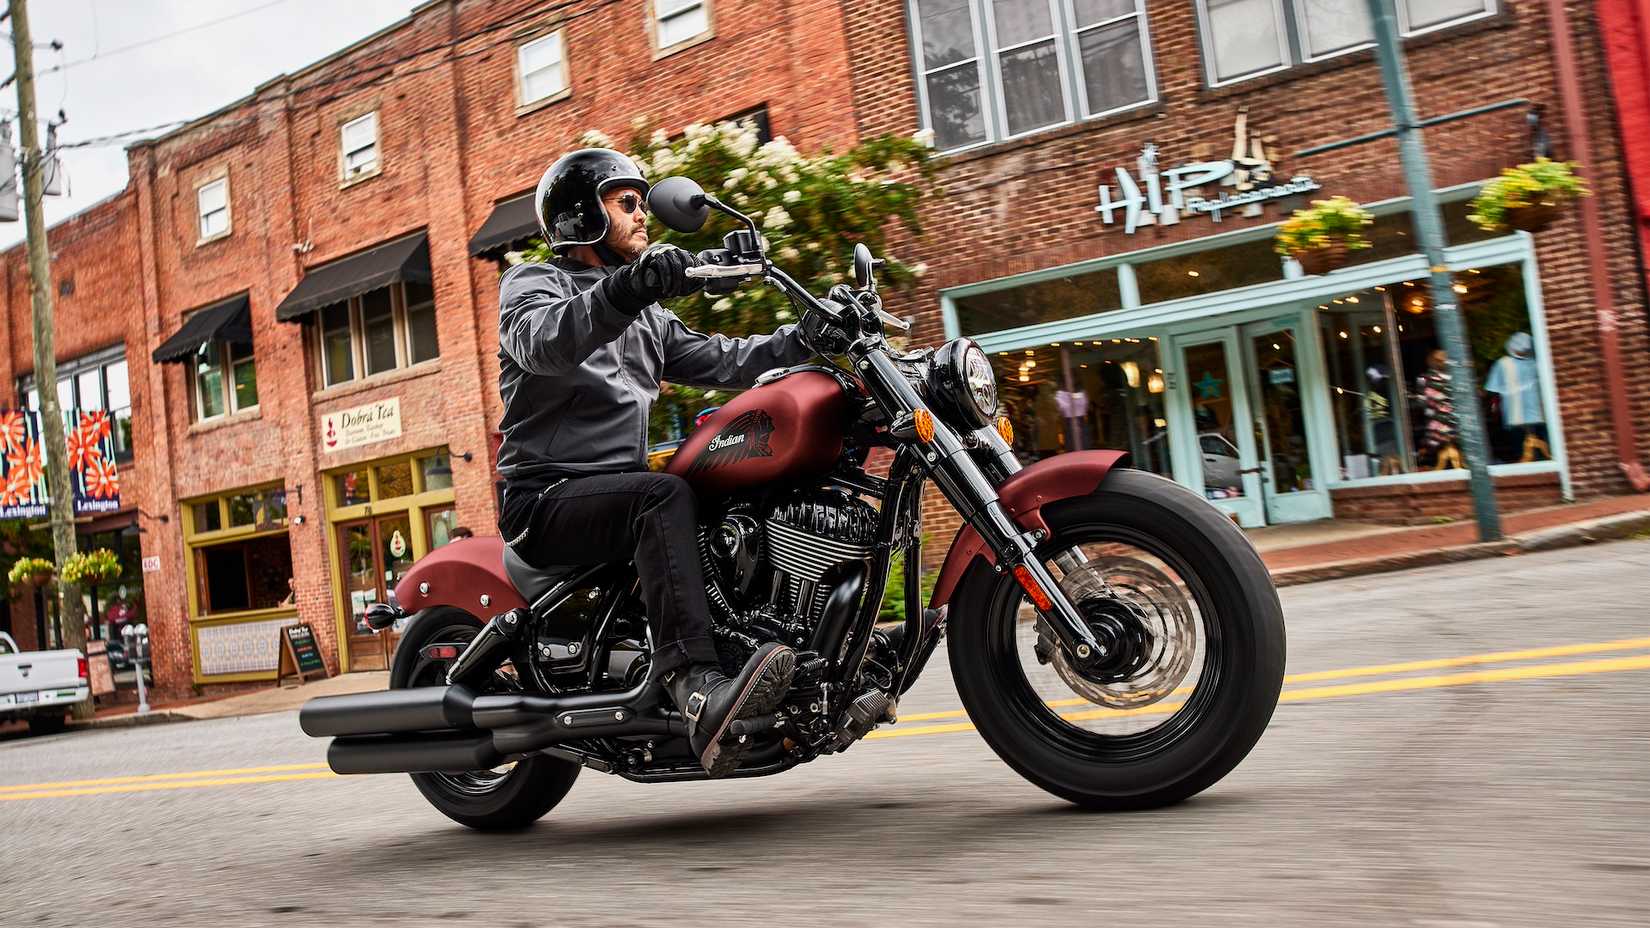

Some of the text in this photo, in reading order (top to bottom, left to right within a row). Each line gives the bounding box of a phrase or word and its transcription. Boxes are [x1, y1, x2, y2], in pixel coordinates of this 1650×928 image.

[375, 404, 394, 420] Tea
[708, 433, 745, 452] Indian
[77, 499, 119, 513] Lexington
